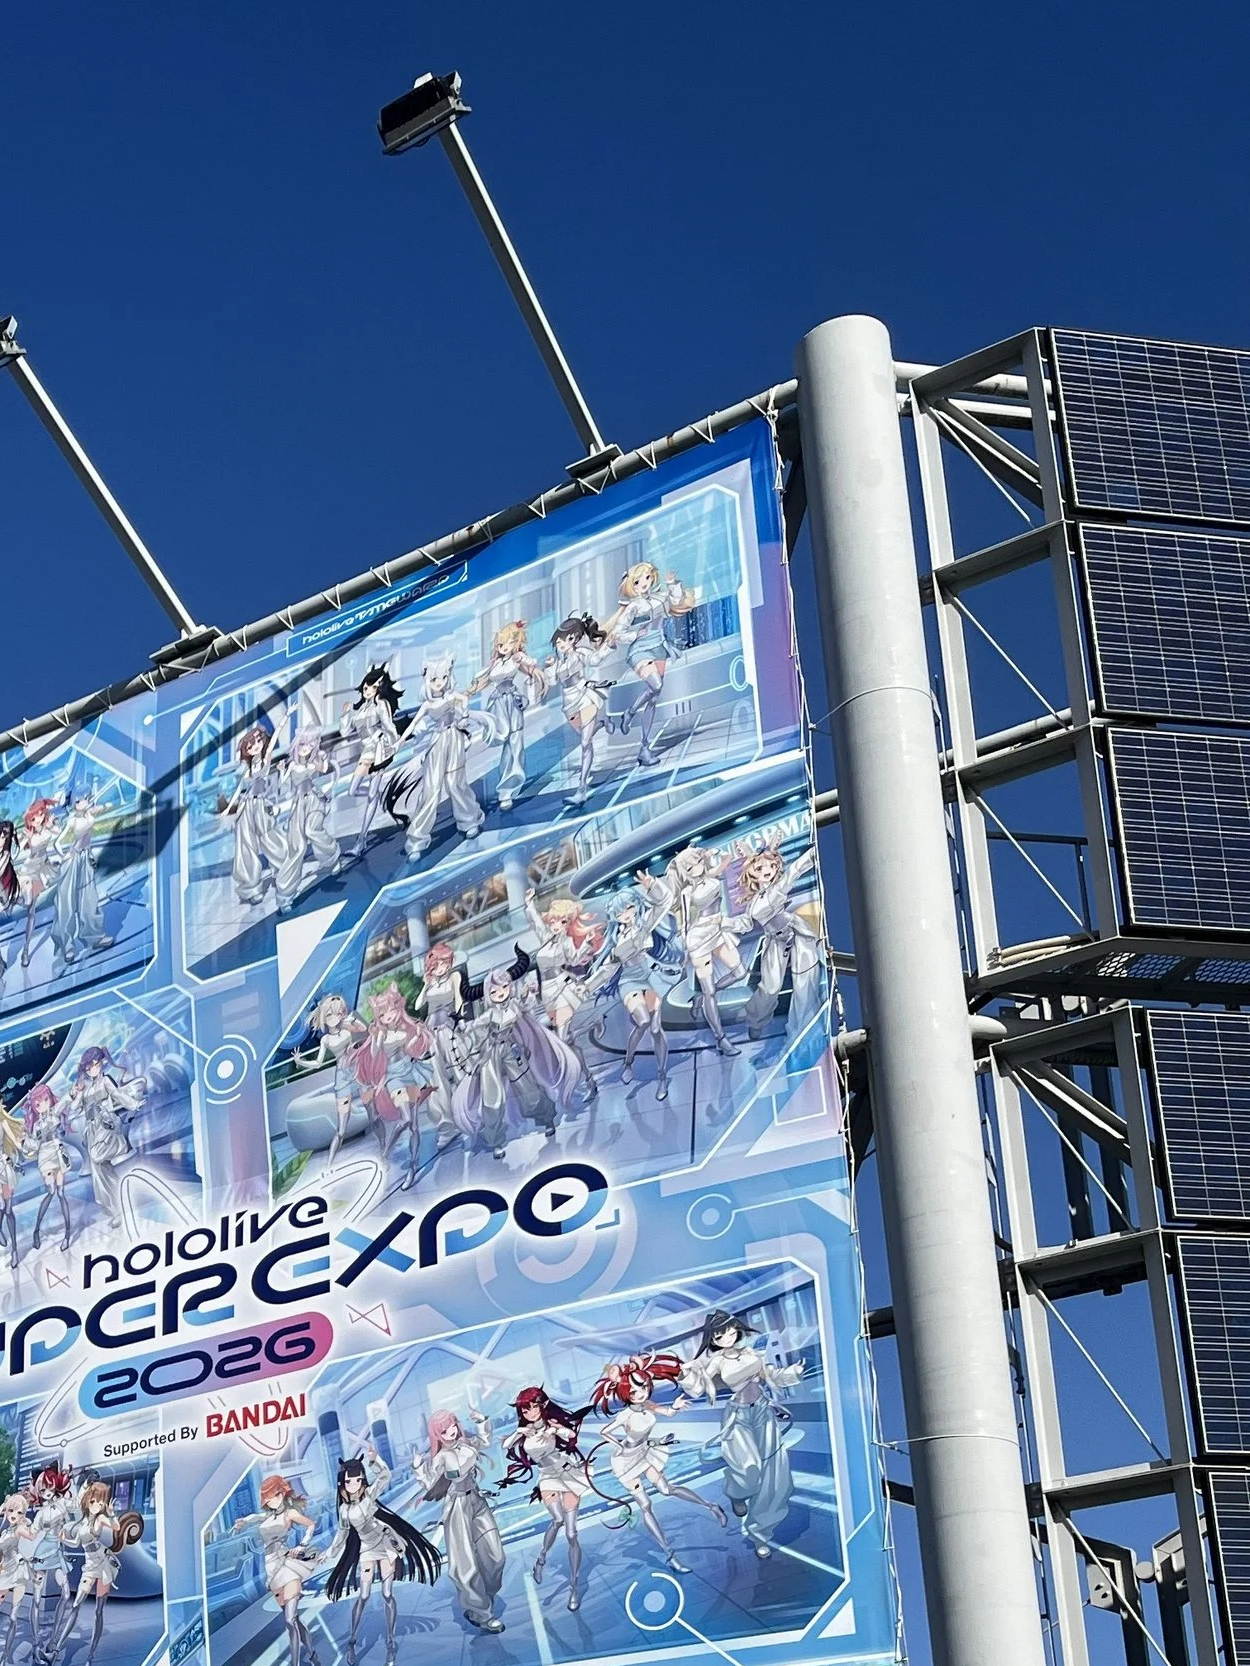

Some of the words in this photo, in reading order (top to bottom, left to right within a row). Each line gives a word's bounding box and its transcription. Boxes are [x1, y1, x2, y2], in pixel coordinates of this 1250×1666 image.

[302, 616, 354, 645] hololive
[83, 1196, 328, 1290] hololive
[251, 1163, 608, 1305] EXPO
[94, 1321, 316, 1409] 2026
[103, 1428, 176, 1457] Supported
[180, 1425, 199, 1441] By
[206, 1393, 306, 1437] BANDAI
